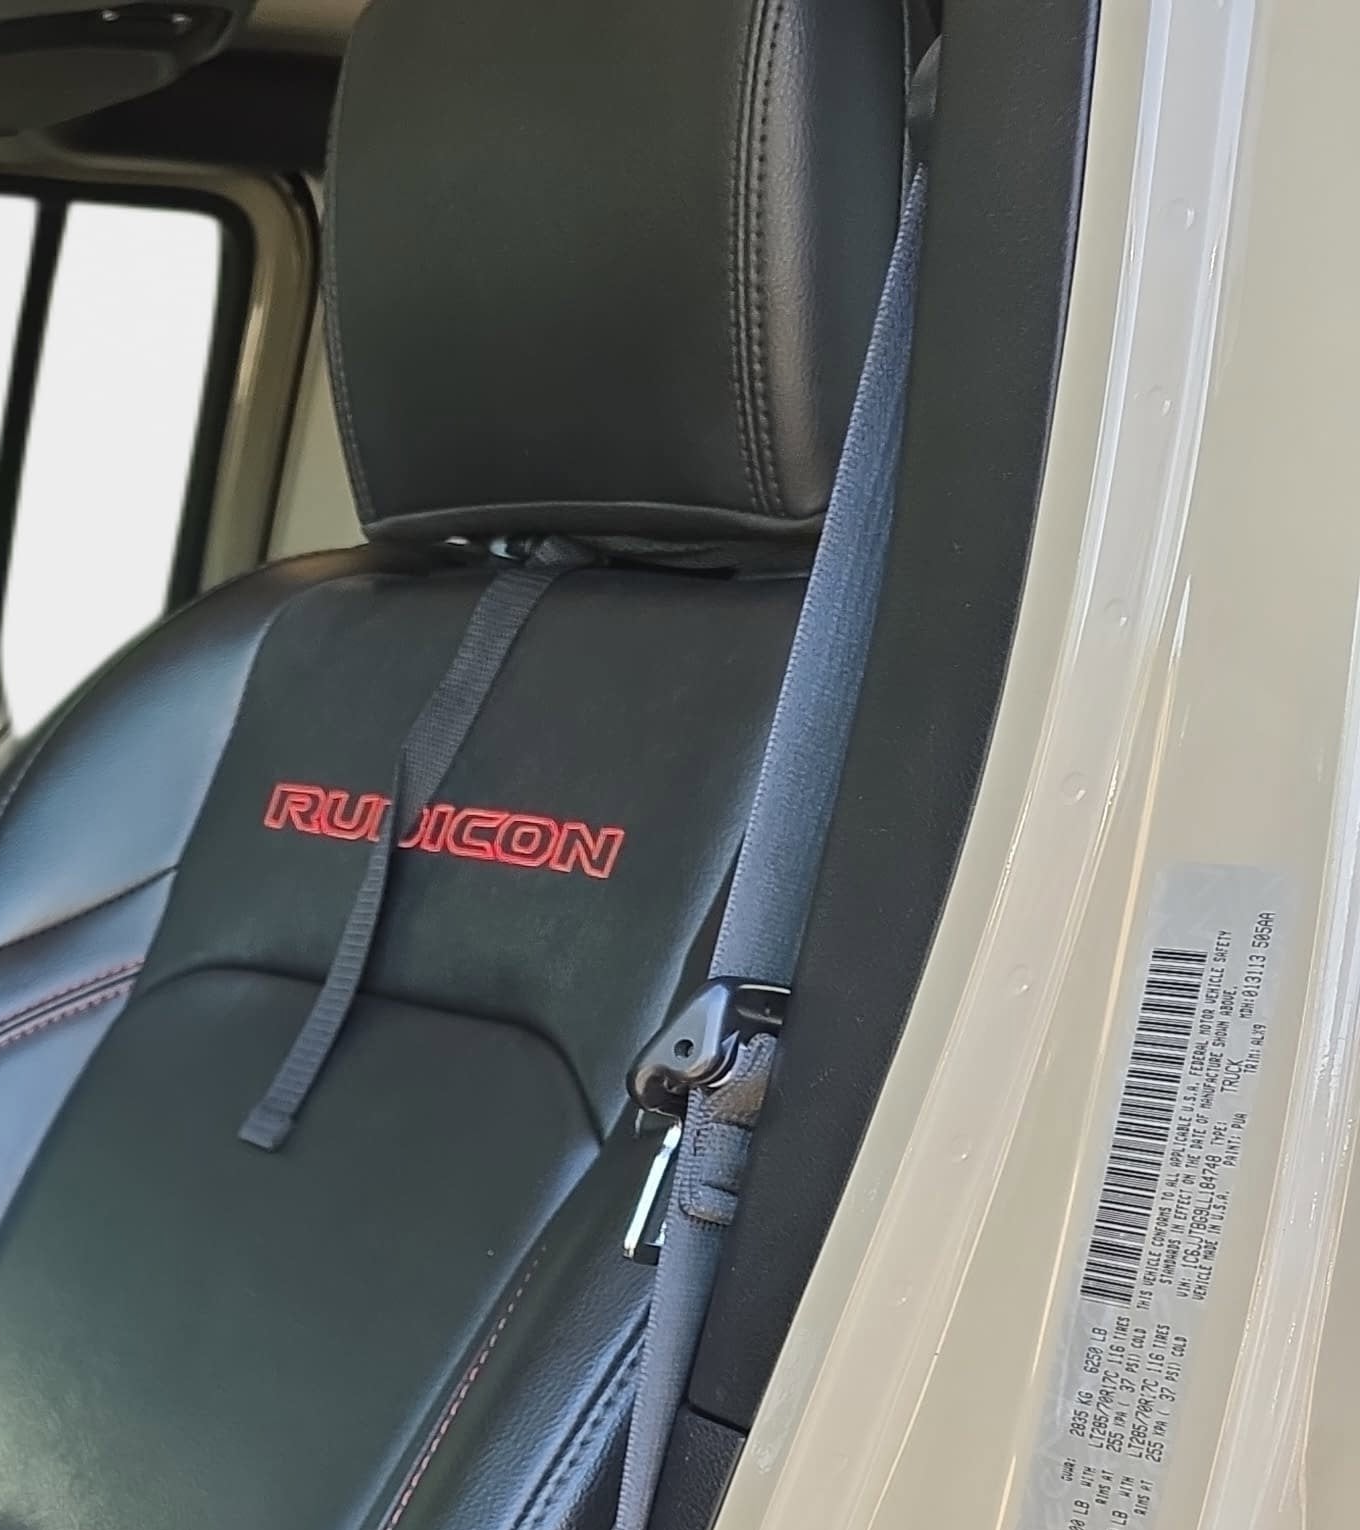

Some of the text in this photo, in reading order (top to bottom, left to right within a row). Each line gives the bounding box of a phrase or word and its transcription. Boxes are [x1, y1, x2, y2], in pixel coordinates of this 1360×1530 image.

[1250, 1023, 1266, 1046] ALX9
[1176, 1277, 1191, 1297] VIN:
[1209, 1121, 1228, 1145] TYPE:
[1219, 1058, 1243, 1092] TRUCK
[1251, 912, 1274, 948] 505AA
[1136, 930, 1231, 1310] THIS VEHICLE CONFORMS TO ALL APPLICABLE U.S.A. FEDERAL MOTOR VEHICLE SAFETY
[1231, 1112, 1247, 1129] PUA
[1159, 985, 1237, 1284] STANDARDS IN EFFECT ON THE DATE OF MANUFACTURE SHOWN ABOVE.
[1222, 1135, 1241, 1166] PAINT:
[1210, 1190, 1229, 1221] U.S.A.
[1206, 1223, 1221, 1234] IN
[1202, 1238, 1218, 1260] MADE
[1192, 1264, 1212, 1300] VEHICLE
[1090, 1326, 1108, 1342] LB
[1113, 1315, 1130, 1340] TIRES
[1130, 1327, 1147, 1349] COLD
[1152, 1323, 1170, 1349] TIRES
[1106, 1343, 1125, 1365] 116
[1170, 1335, 1187, 1357] COLD
[1083, 1346, 1103, 1374] 6250
[1145, 1352, 1165, 1373] 116
[1118, 1377, 1135, 1393] 37
[1158, 1386, 1176, 1402] 37
[1077, 1390, 1093, 1406] KG
[1088, 1369, 1119, 1448] LT285/70R17C
[1068, 1409, 1089, 1437] 2835
[1113, 1410, 1126, 1427] KPA
[1152, 1420, 1167, 1436] KPA
[1105, 1430, 1124, 1453] 255
[1144, 1439, 1164, 1463] 255
[1080, 1465, 1095, 1487] WITH
[1100, 1469, 1113, 1481] AT
[1119, 1475, 1134, 1497] WITH
[1139, 1479, 1152, 1491] AT
[1094, 1483, 1111, 1505] RIMS
[1133, 1493, 1150, 1515] RIMS
[1072, 1499, 1090, 1515] LB
[1111, 1509, 1128, 1526] LB
